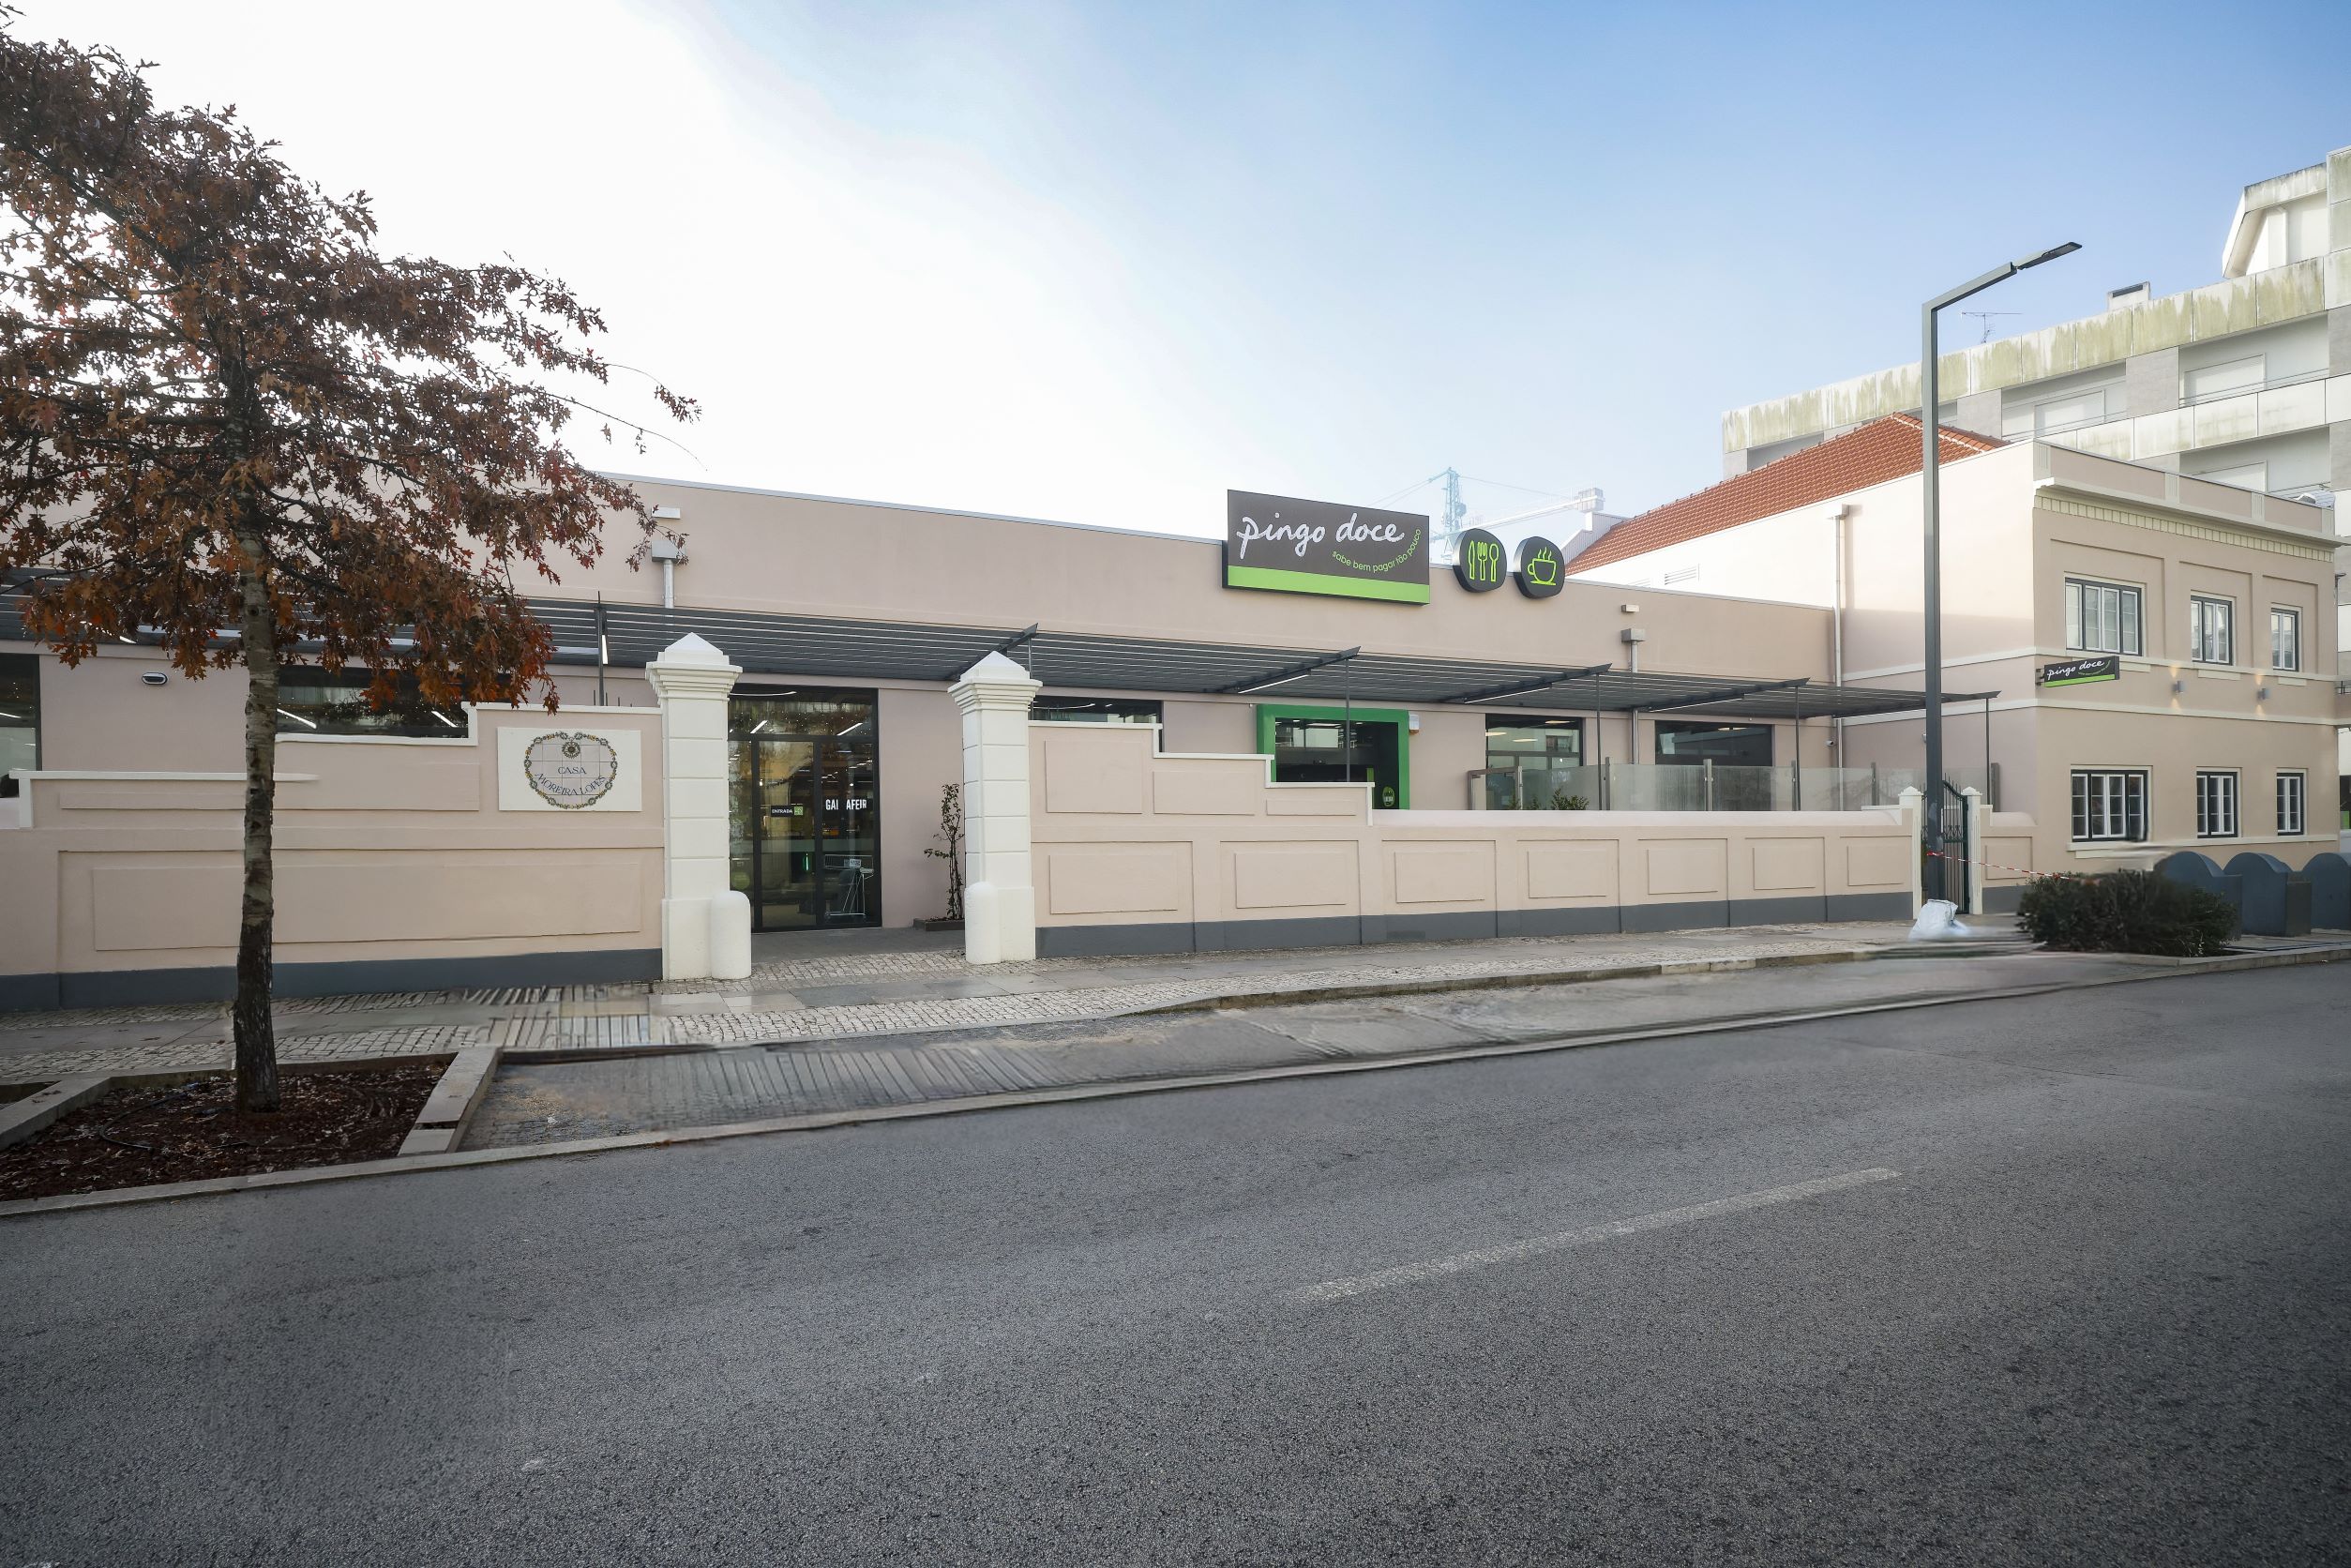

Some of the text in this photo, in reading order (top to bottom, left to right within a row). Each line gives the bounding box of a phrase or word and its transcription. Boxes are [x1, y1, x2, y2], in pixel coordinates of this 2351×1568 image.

[1236, 512, 1405, 560] pingo doce
[1332, 529, 1422, 573] sabe bem pagar tão pouco
[2046, 666, 2076, 681] pingo
[2078, 660, 2105, 671] doce
[557, 766, 587, 775] CASA
[535, 773, 607, 796] MOREIRA LOPES
